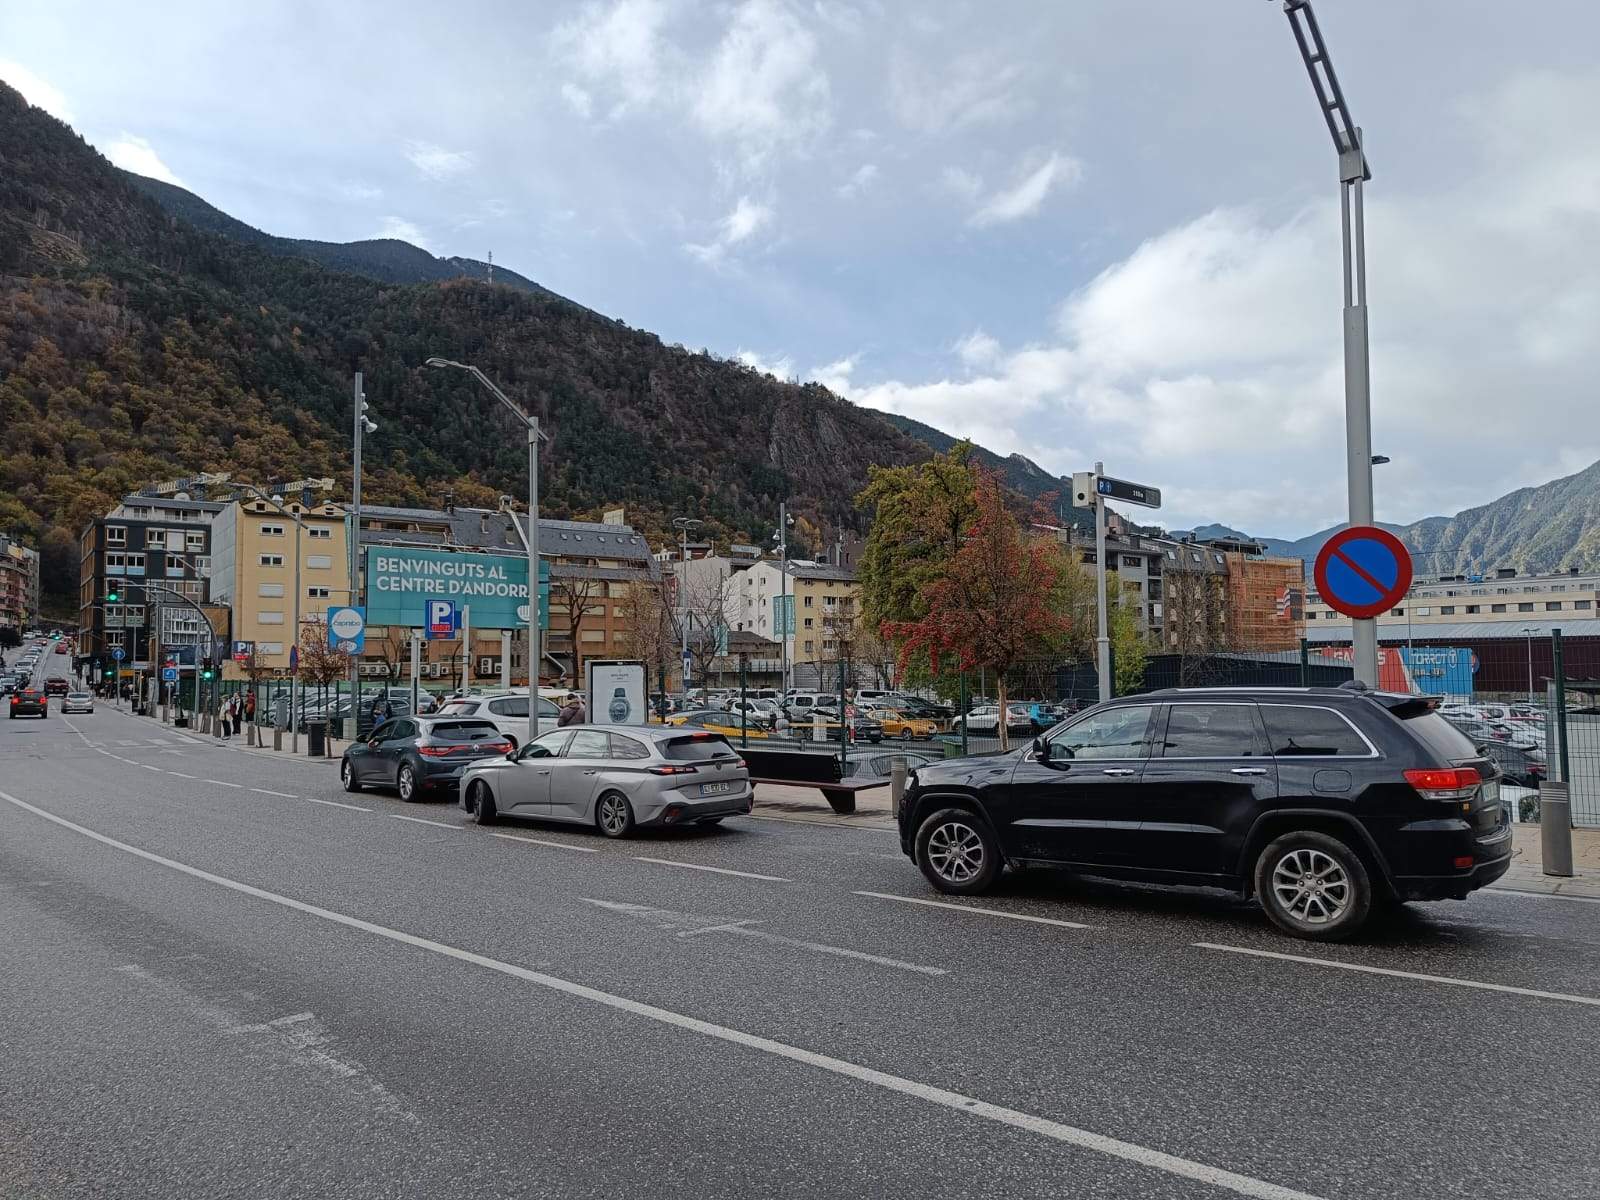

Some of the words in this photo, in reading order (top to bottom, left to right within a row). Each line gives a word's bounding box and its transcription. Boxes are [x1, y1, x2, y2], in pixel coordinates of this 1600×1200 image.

[376, 557, 485, 578] BENVINGUTS
[487, 566, 508, 579] AL
[376, 577, 445, 593] CENTRE
[449, 580, 541, 599] D'ANDORR
[431, 602, 451, 625] P
